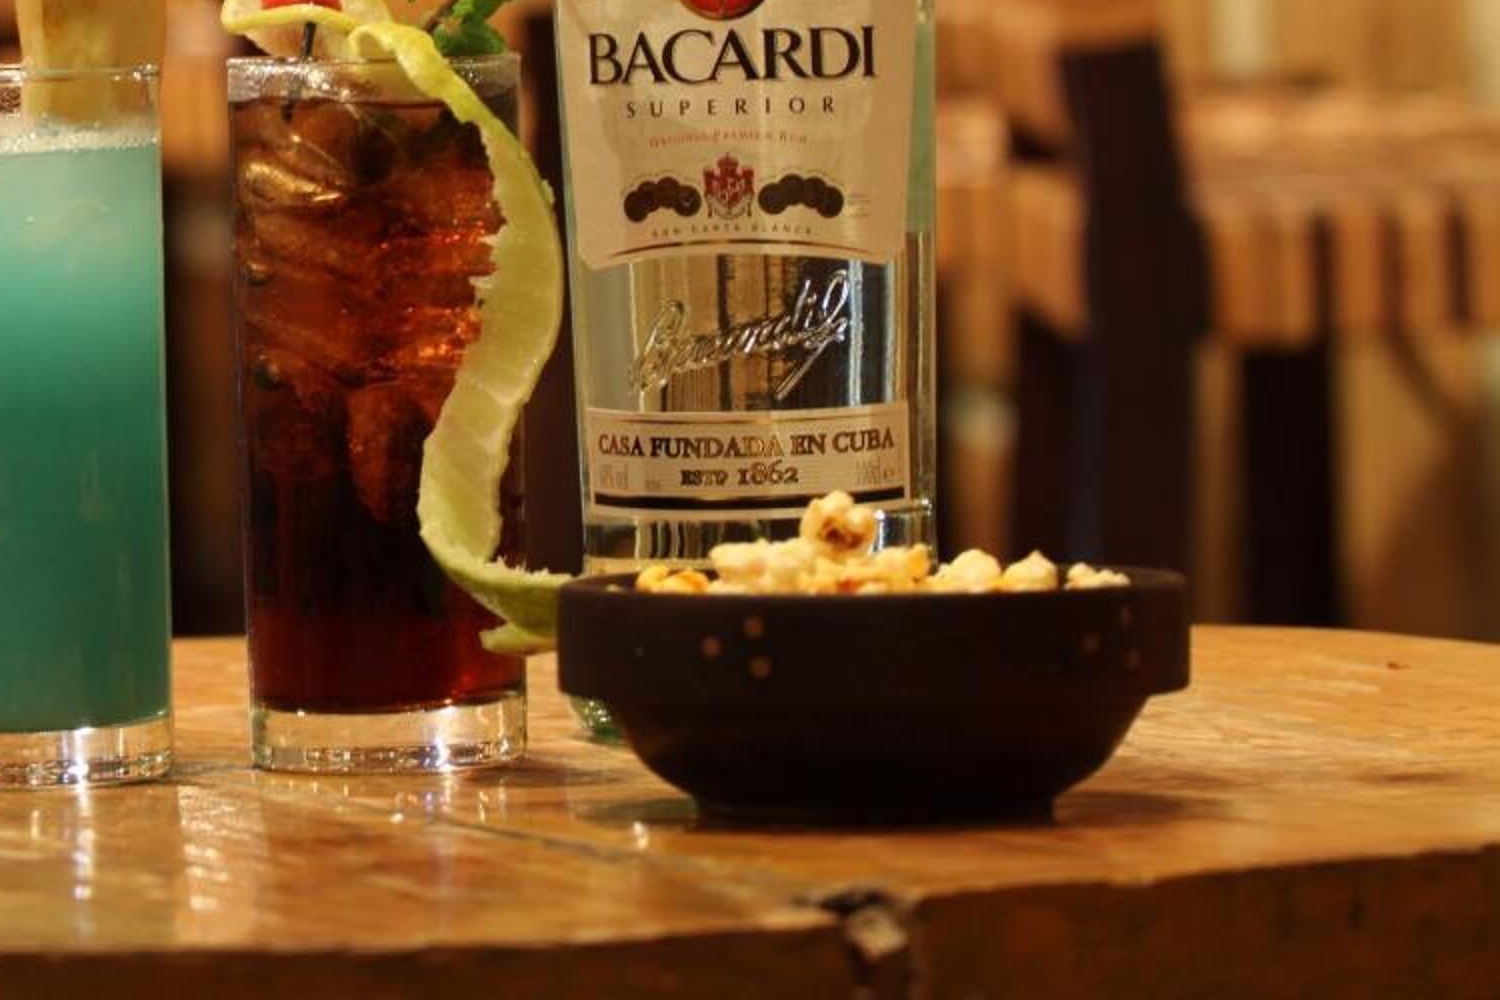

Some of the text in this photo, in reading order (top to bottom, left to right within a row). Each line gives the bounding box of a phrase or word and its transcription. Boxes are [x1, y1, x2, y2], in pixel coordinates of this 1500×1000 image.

[588, 25, 876, 86] BACARDI
[626, 95, 835, 119] SUPERIOR
[598, 428, 895, 459] CASA FUNDADA EN CUBA
[737, 460, 799, 486] 1862
